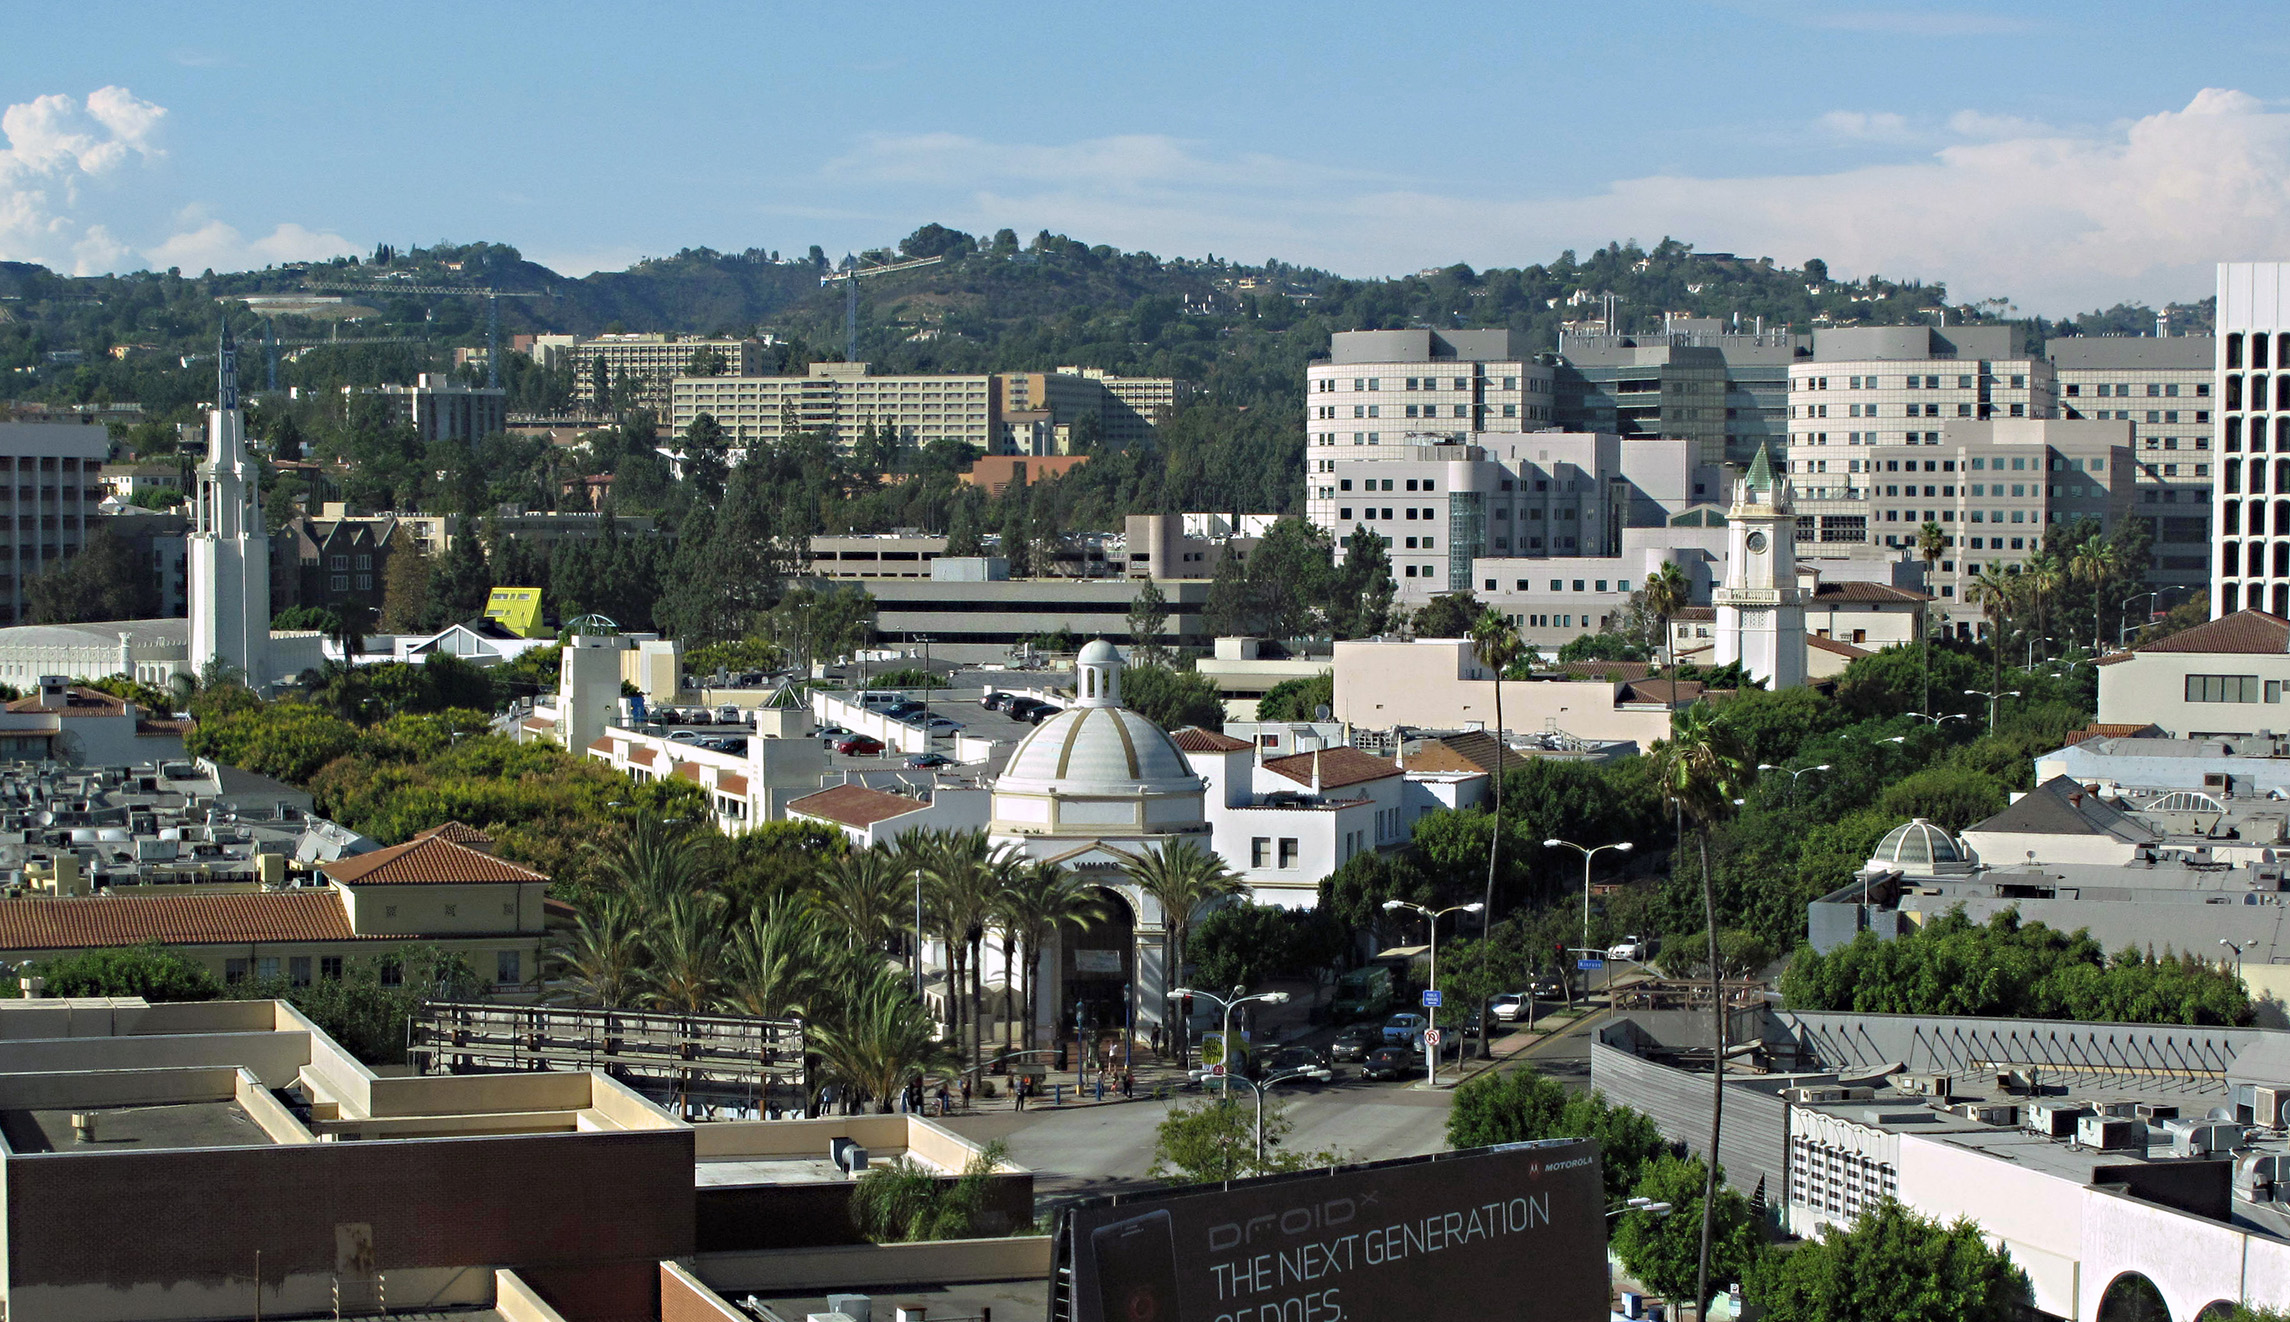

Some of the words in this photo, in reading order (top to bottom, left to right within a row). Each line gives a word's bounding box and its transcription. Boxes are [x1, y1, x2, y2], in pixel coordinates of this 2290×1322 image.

[225, 355, 234, 404] FOX
[1073, 861, 1119, 870] YAMATO
[1544, 1156, 1593, 1172] MOTOROLA
[1208, 1197, 1356, 1252] DROID
[1209, 1254, 1273, 1300] THE
[1279, 1234, 1360, 1286] NEXT
[1364, 1191, 1550, 1266] GENERATION
